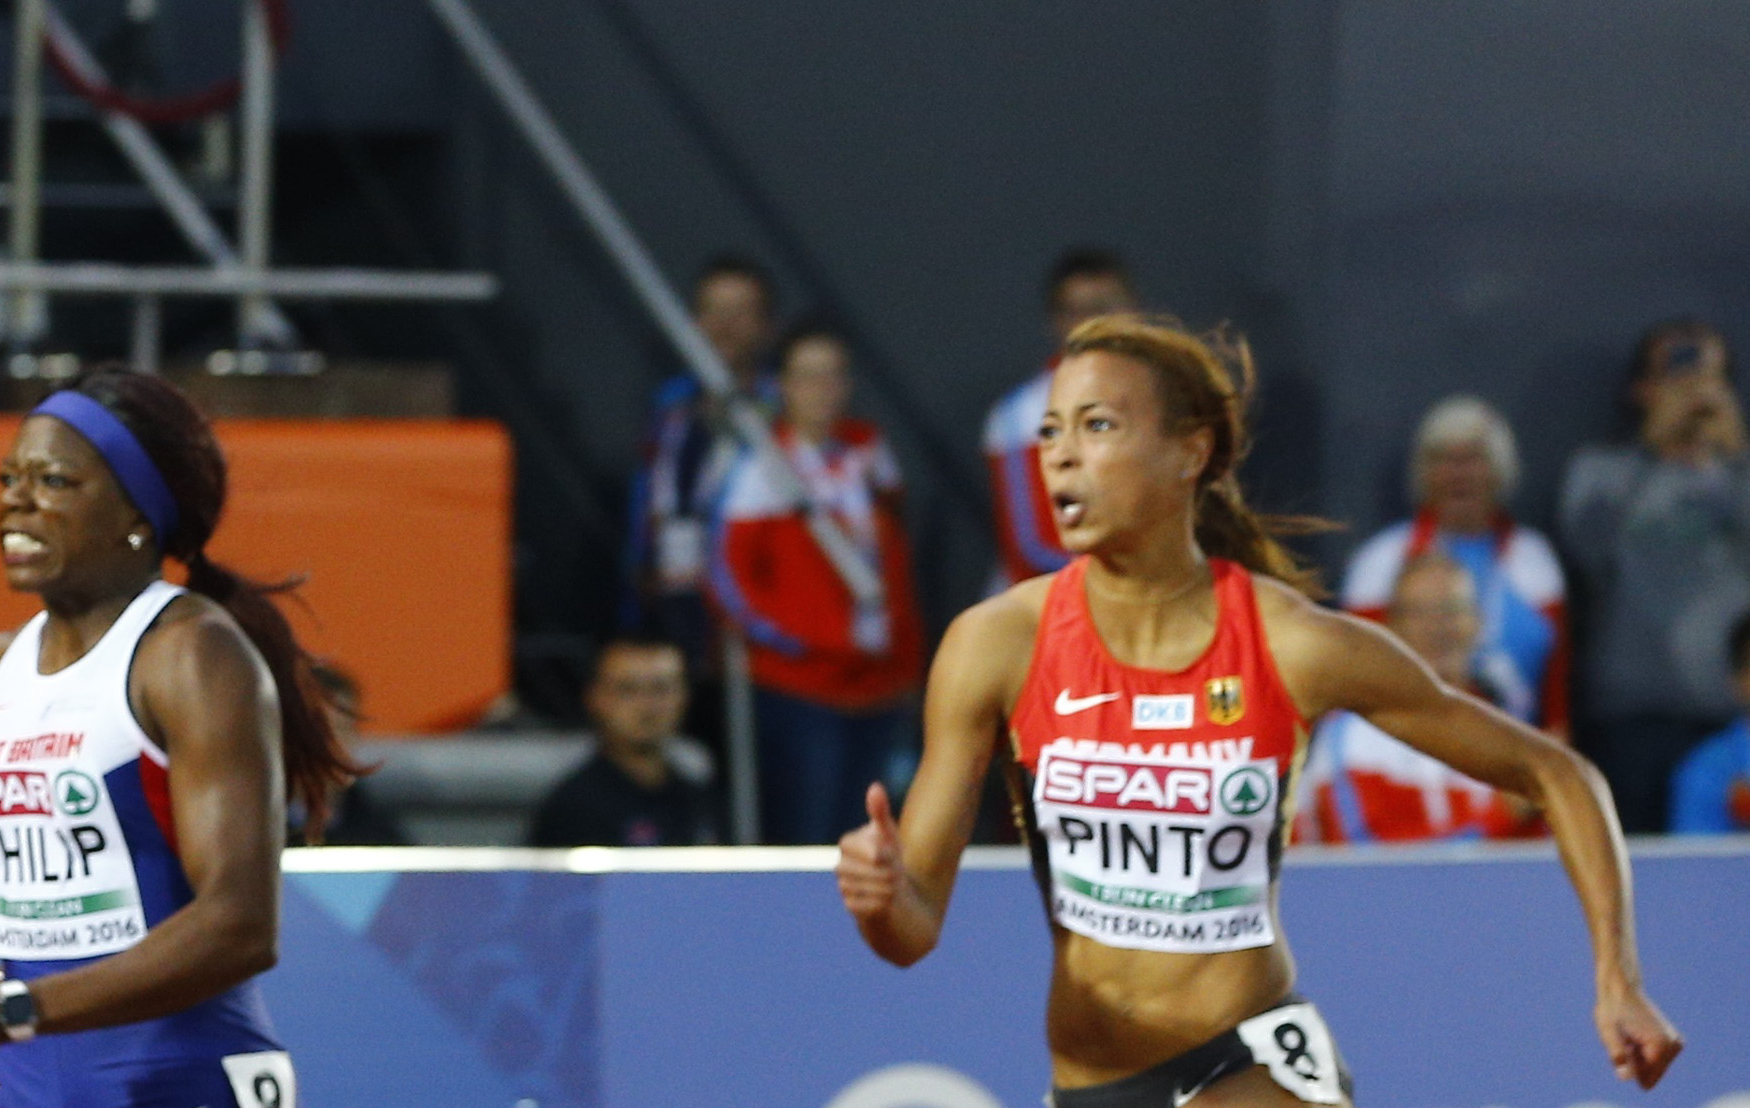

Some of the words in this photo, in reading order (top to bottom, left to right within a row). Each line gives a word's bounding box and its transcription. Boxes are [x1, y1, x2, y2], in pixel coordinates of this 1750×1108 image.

[1045, 757, 1211, 813] SPAR
[1058, 815, 1252, 877] PINTO
[86, 916, 139, 945] 2016
[1055, 898, 1205, 941] AMSTERDAM
[1214, 911, 1266, 940] 2016
[1274, 1022, 1320, 1081] 8
